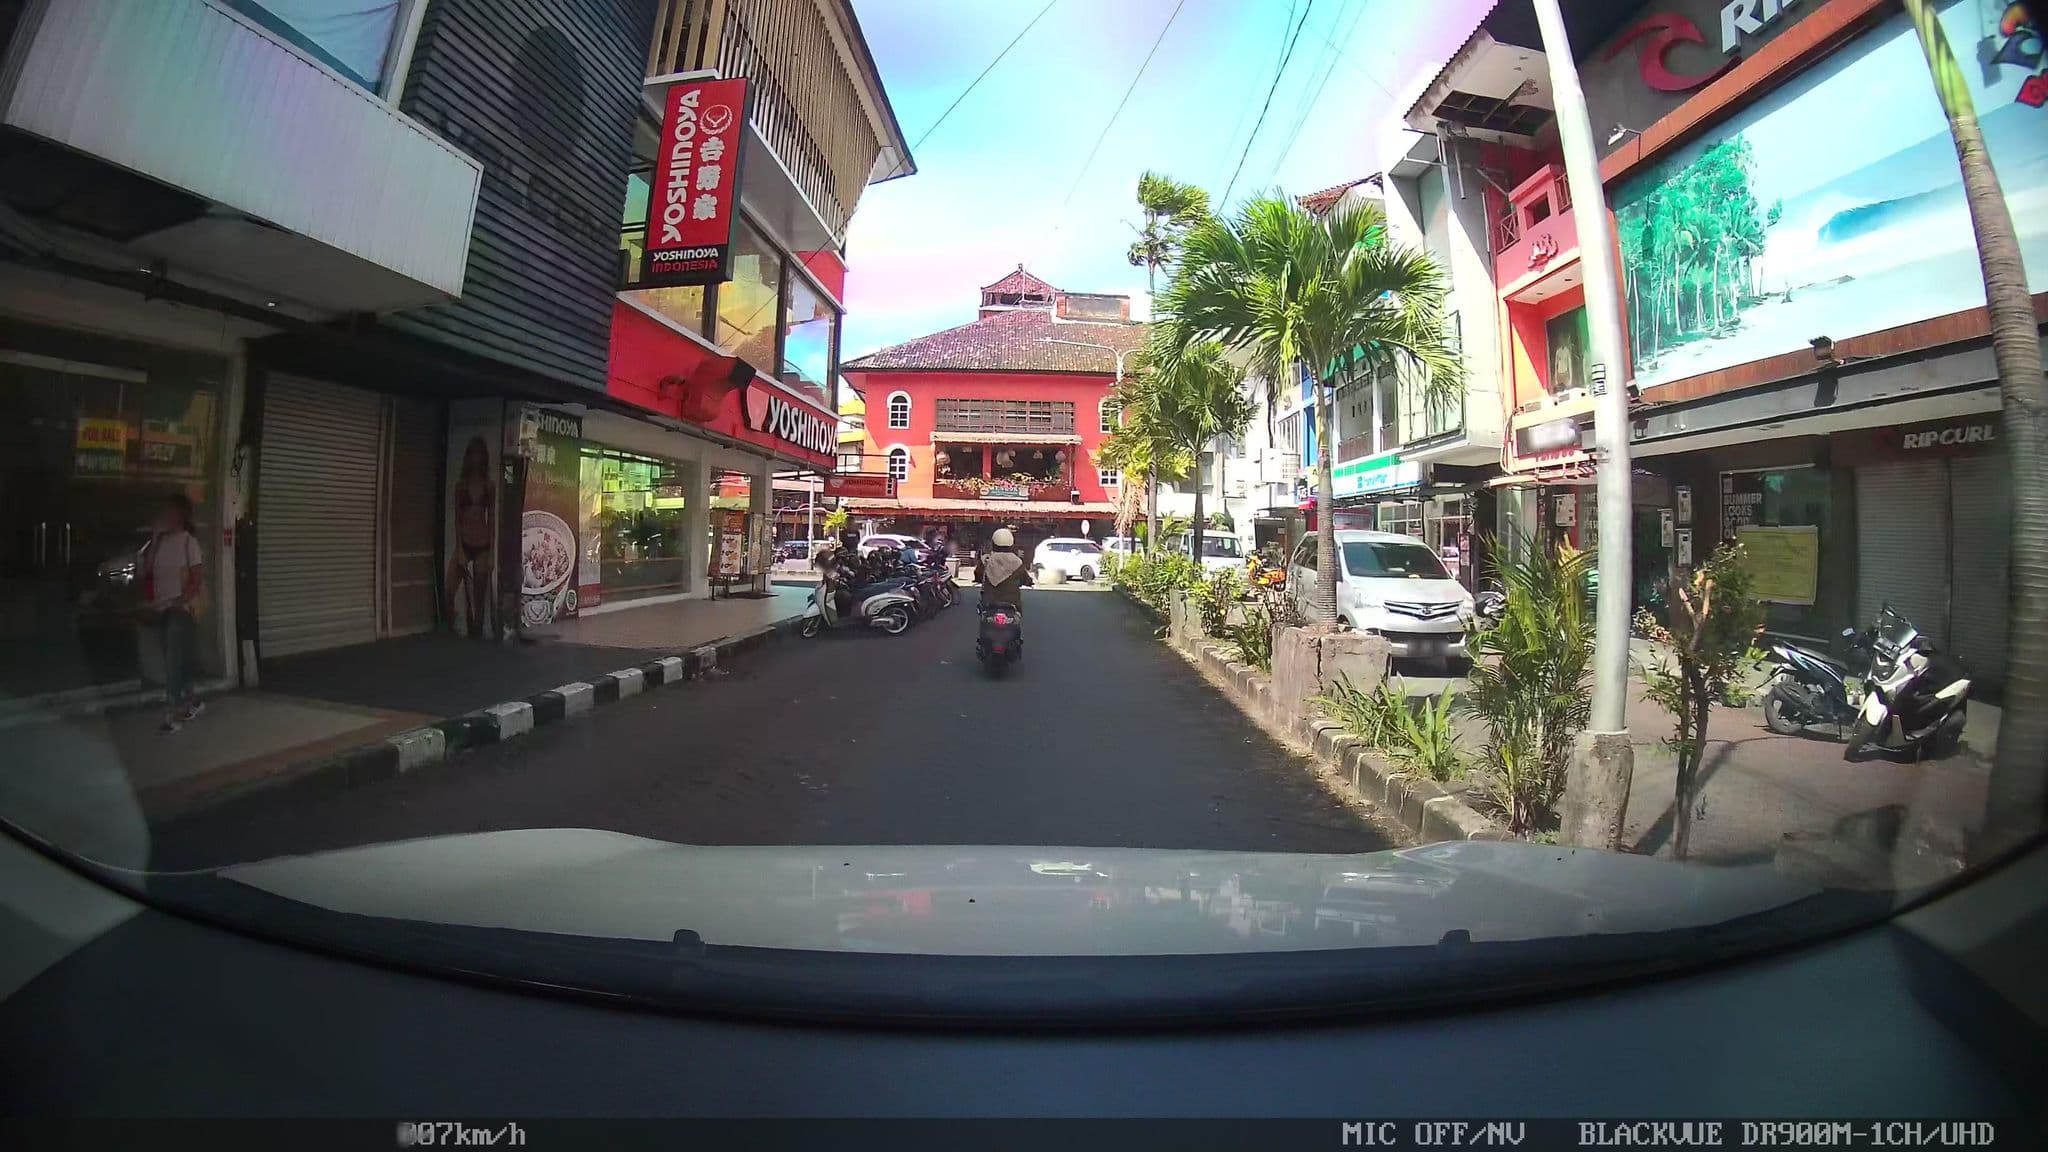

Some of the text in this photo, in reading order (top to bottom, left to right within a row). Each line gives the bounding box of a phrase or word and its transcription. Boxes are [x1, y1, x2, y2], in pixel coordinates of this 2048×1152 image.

[1720, 0, 1798, 54] RI
[660, 89, 701, 244] YOSHINOYA
[651, 259, 718, 273] INDONESIA
[653, 247, 719, 261] YOSHINOYA
[768, 395, 838, 457] YOSHINOYA
[1723, 492, 1763, 506] SUMMER
